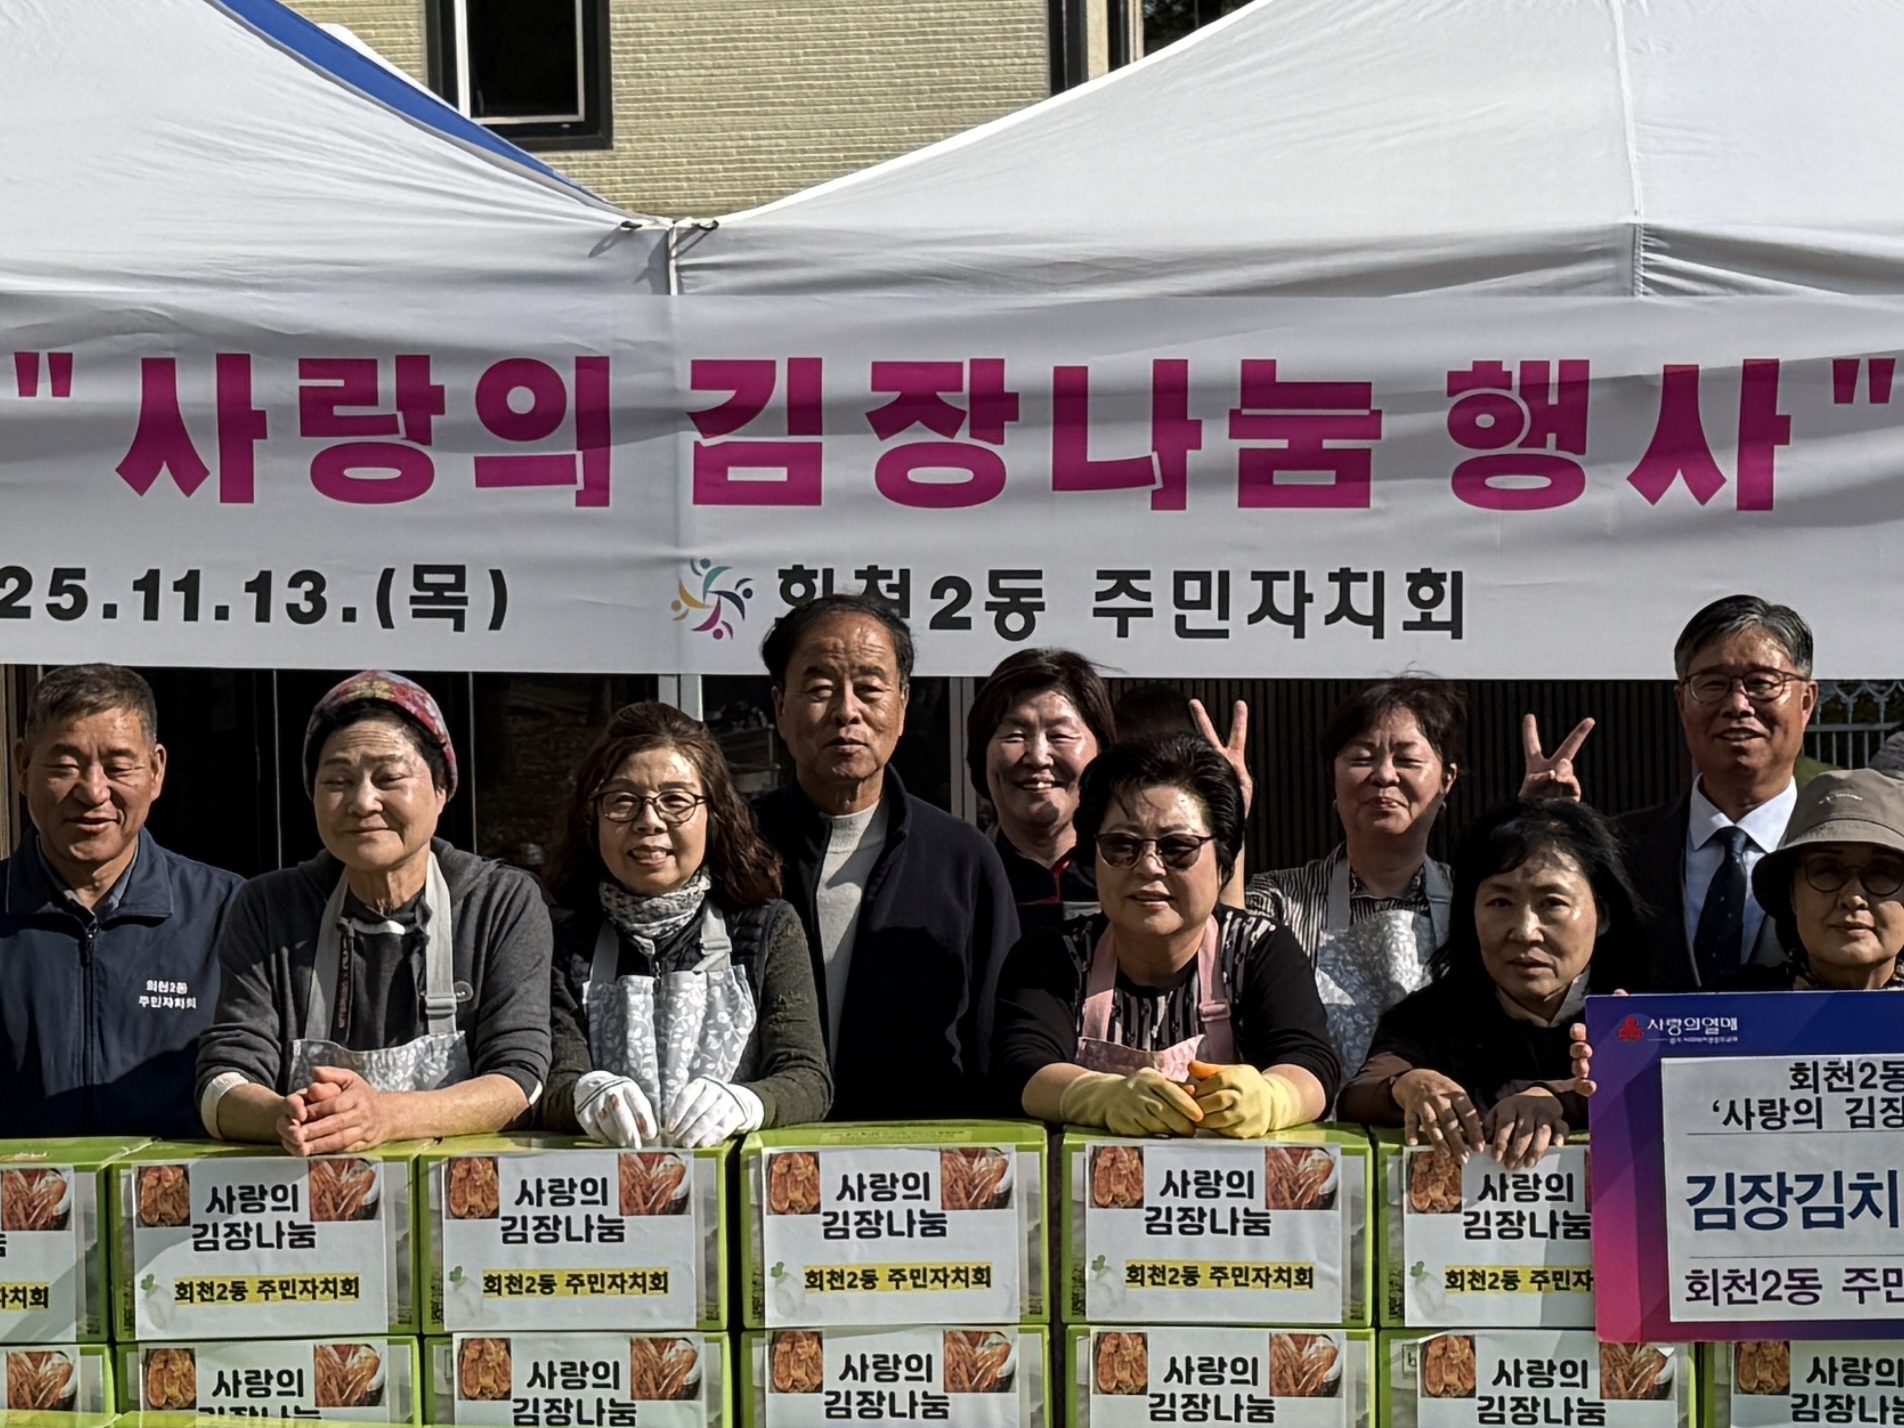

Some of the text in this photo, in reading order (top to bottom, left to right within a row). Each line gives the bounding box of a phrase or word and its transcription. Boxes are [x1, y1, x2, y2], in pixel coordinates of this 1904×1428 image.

[14, 352, 611, 506] "사랑의
[690, 358, 1382, 510] 김장나눔
[1447, 358, 1896, 511] 행사"
[1093, 567, 1463, 639] 주민자치회
[1647, 1016, 1738, 1036] 사랑의열매
[206, 1184, 298, 1214] 사랑의
[515, 1177, 608, 1207] 사랑의
[836, 1172, 930, 1202] 사랑의
[1160, 1170, 1254, 1199] 사랑의
[1478, 1173, 1574, 1202] 사랑의
[1686, 1170, 1898, 1231] 김장김치
[192, 1221, 316, 1251] 김장나눔
[501, 1214, 625, 1244] 김장나눔
[823, 1209, 947, 1239] 김장나눔
[1145, 1206, 1271, 1236] 김장나눔
[175, 1277, 359, 1303] 회천2동 주민자치회
[483, 1271, 668, 1296] 회천2동 주민자치회
[805, 1266, 991, 1291] 회천2동 주민자치회
[1126, 1265, 1313, 1289] 회천2동 주민자치회
[1445, 1270, 1521, 1291] 회천2동
[1685, 1268, 1822, 1306] 회천2동
[527, 1361, 619, 1390] 사랑의
[839, 1354, 932, 1383] 사랑의
[1164, 1356, 1258, 1386] 사랑의
[1492, 1359, 1588, 1389] 사랑의
[1806, 1356, 1904, 1387] 사랑의
[513, 1398, 636, 1427] 김장나눔
[824, 1390, 950, 1419] 김장나눔
[1149, 1393, 1275, 1423] 김장나눔
[1477, 1396, 1606, 1426] 김장나눔
